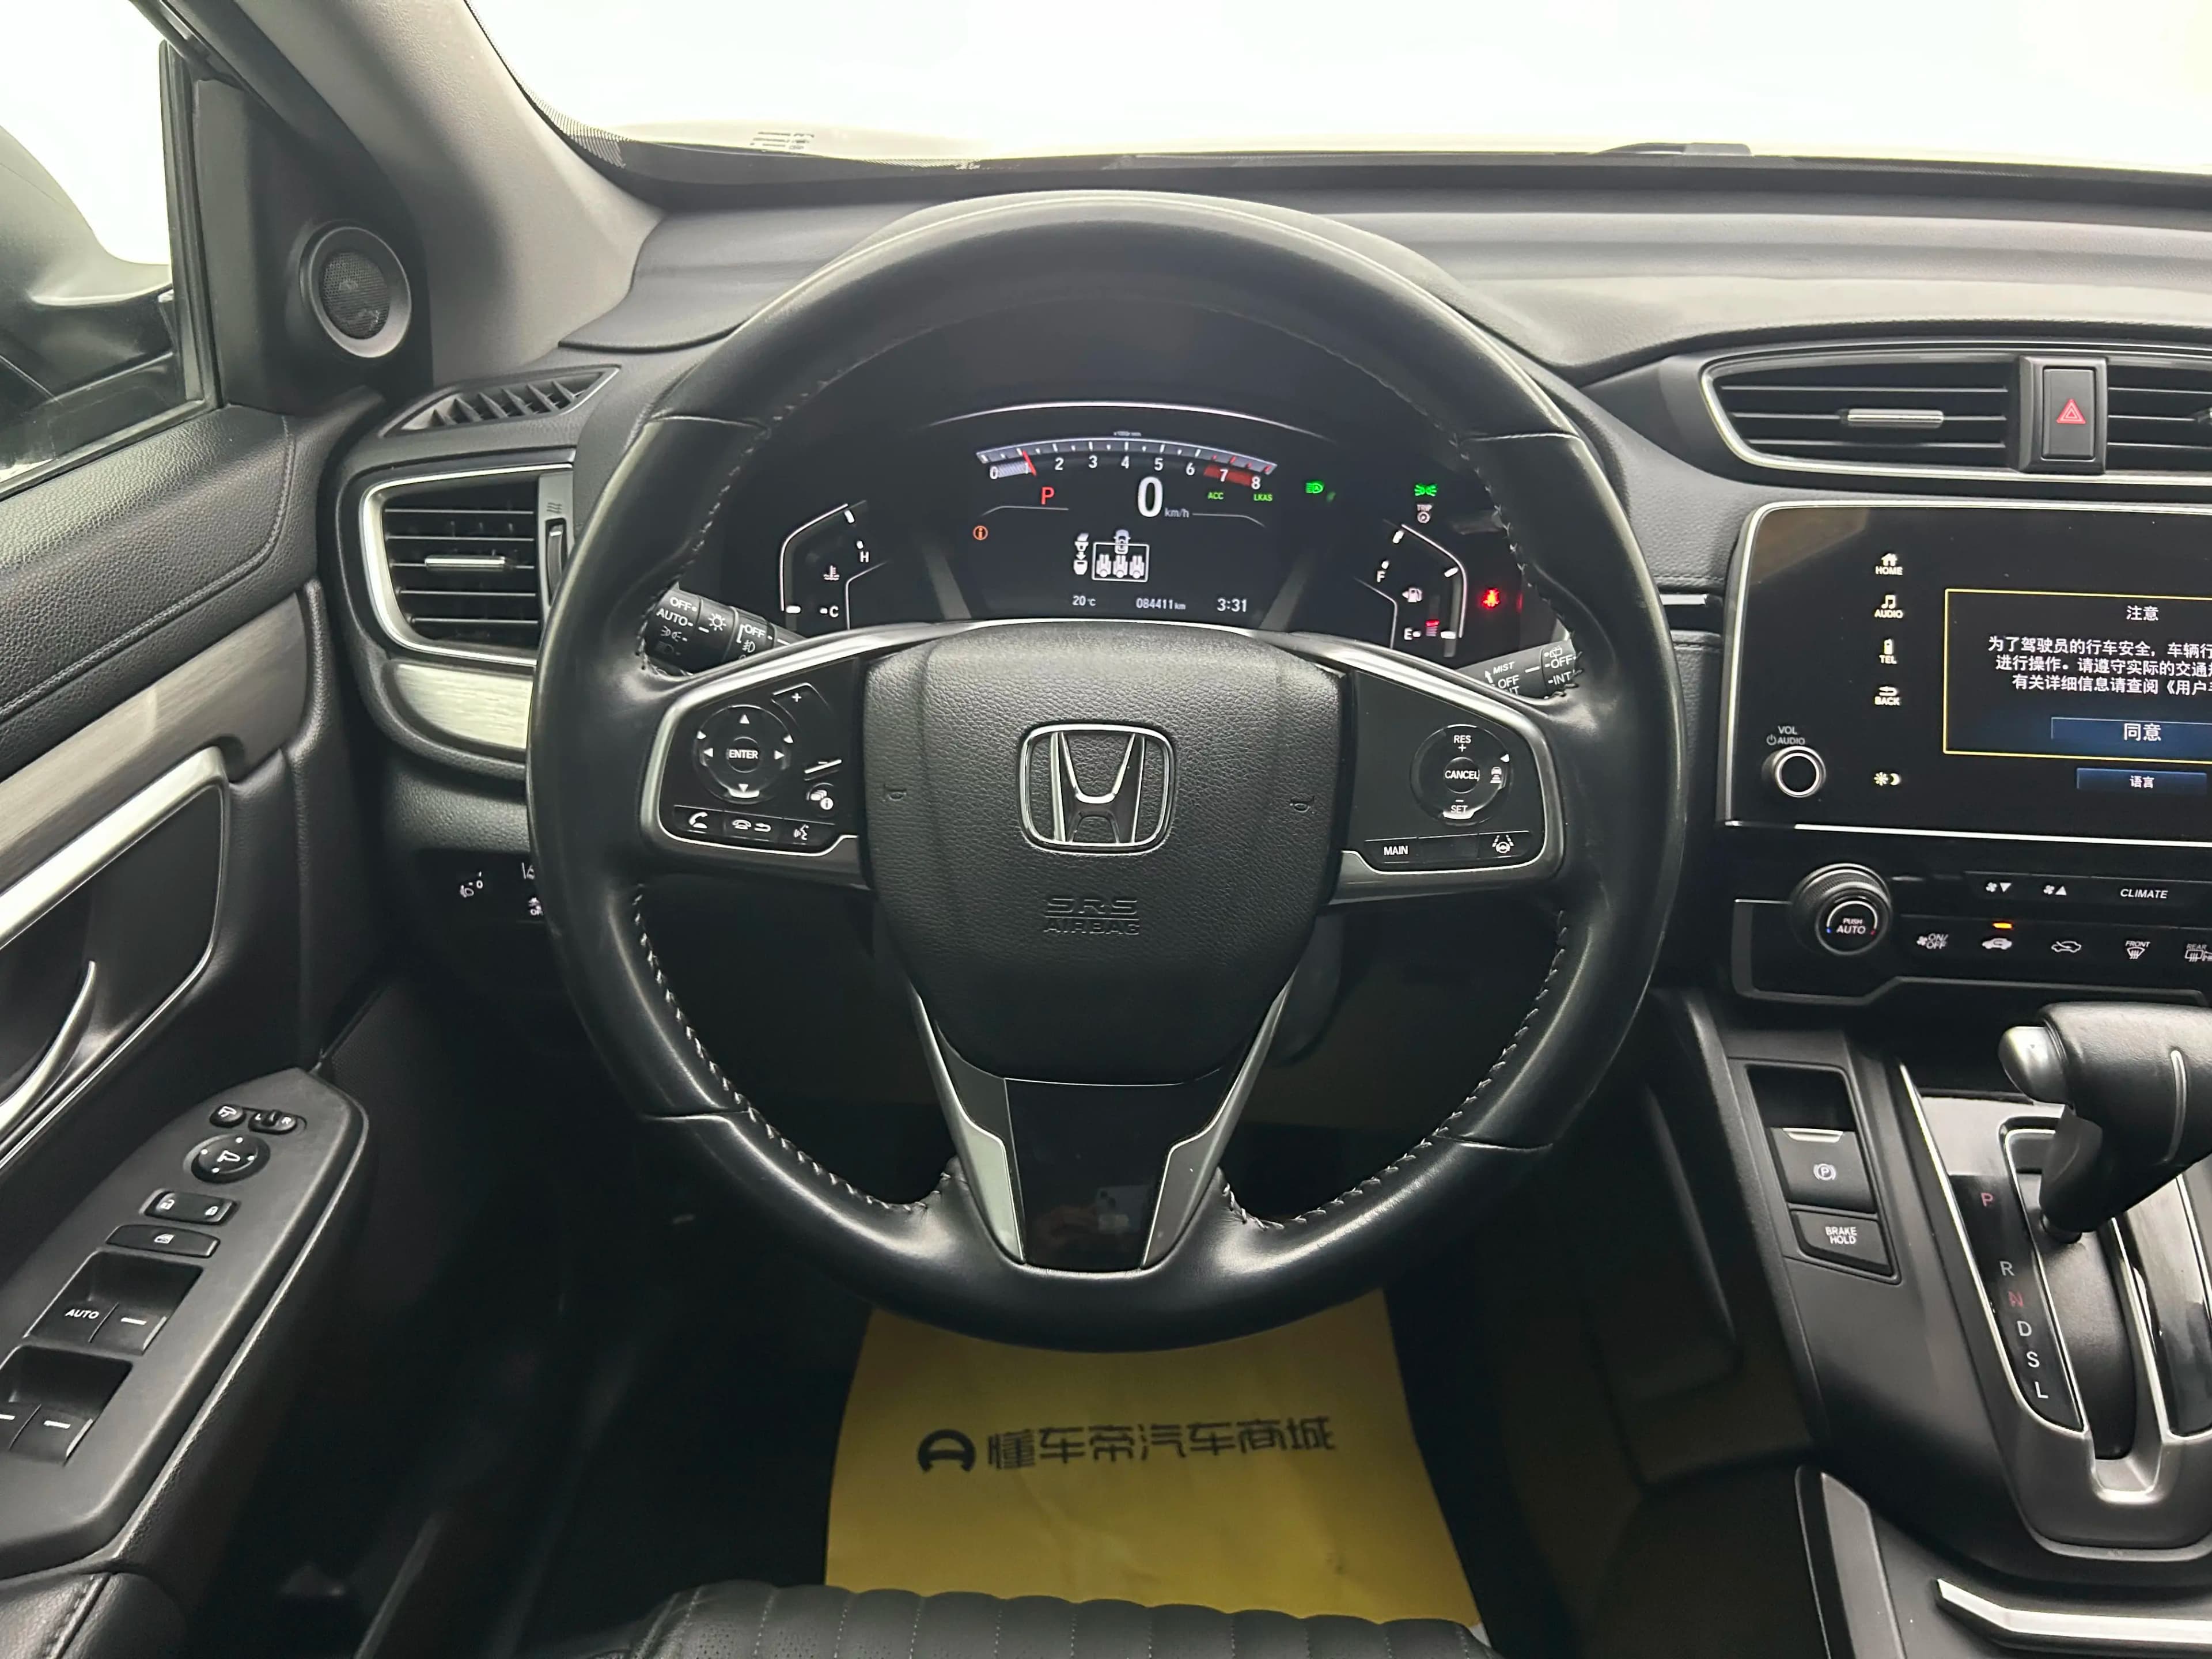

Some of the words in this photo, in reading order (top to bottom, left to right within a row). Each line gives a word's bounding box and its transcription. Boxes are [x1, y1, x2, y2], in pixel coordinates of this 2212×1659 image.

[989, 465, 998, 479] 0
[1055, 457, 1064, 471] 2
[1088, 456, 1097, 469] 3
[1121, 456, 1130, 469] 4
[1154, 457, 1164, 471] 5
[1185, 462, 1195, 476] 6
[1219, 469, 1228, 482] 7
[1251, 476, 1261, 490] 8
[1041, 487, 1055, 505] P
[1138, 477, 1163, 517] 0
[1165, 507, 1190, 518] km/h
[1207, 492, 1224, 500] ACC
[1253, 494, 1273, 502] LKAS
[860, 552, 869, 563] H
[1377, 570, 1385, 582] F
[1875, 566, 1903, 575] HOME
[670, 597, 692, 611] OFF
[1217, 599, 1247, 612] 3:31
[656, 608, 688, 626] AUTO
[829, 606, 839, 618] C
[1874, 609, 1903, 619] AUDIO
[2126, 605, 2159, 622] 注意
[745, 624, 766, 638] OFF
[1404, 628, 1412, 641] E
[1551, 654, 1573, 668] OFF
[1879, 655, 1897, 664] TEL
[1995, 654, 2212, 678] 进行操作。请遵守实际的交通
[1493, 662, 1515, 675] MIST
[1498, 675, 1519, 688] OFF
[1553, 671, 1571, 685] INT
[1874, 696, 1900, 706] BACK
[1778, 726, 1798, 736] VOL
[2123, 723, 2161, 743] 同意
[1453, 735, 1471, 744] RES
[1778, 736, 1805, 746] AUDIO
[729, 749, 759, 759] ENTER
[1445, 770, 1479, 780] CANCEL
[2130, 775, 2154, 789] 语言
[1450, 805, 1468, 814] SET
[1384, 846, 1408, 856] MAIN
[2120, 889, 2168, 900] CLIMATE
[1044, 898, 1138, 914] SRS
[1043, 921, 1141, 935] AIRBAG
[1836, 925, 1866, 934] AUTO
[281, 1116, 292, 1125] R
[1982, 1192, 1994, 1207] P
[1825, 1226, 1858, 1237] BRAKE
[1830, 1234, 1857, 1245] HOLD
[1999, 1261, 2015, 1277] R
[2008, 1291, 2024, 1307] N
[65, 1308, 99, 1320] AUTO
[2017, 1321, 2032, 1337] D
[2027, 1351, 2040, 1368] S
[2035, 1382, 2048, 1399] L
[987, 1416, 1336, 1470] 懂车帝汽车商城
